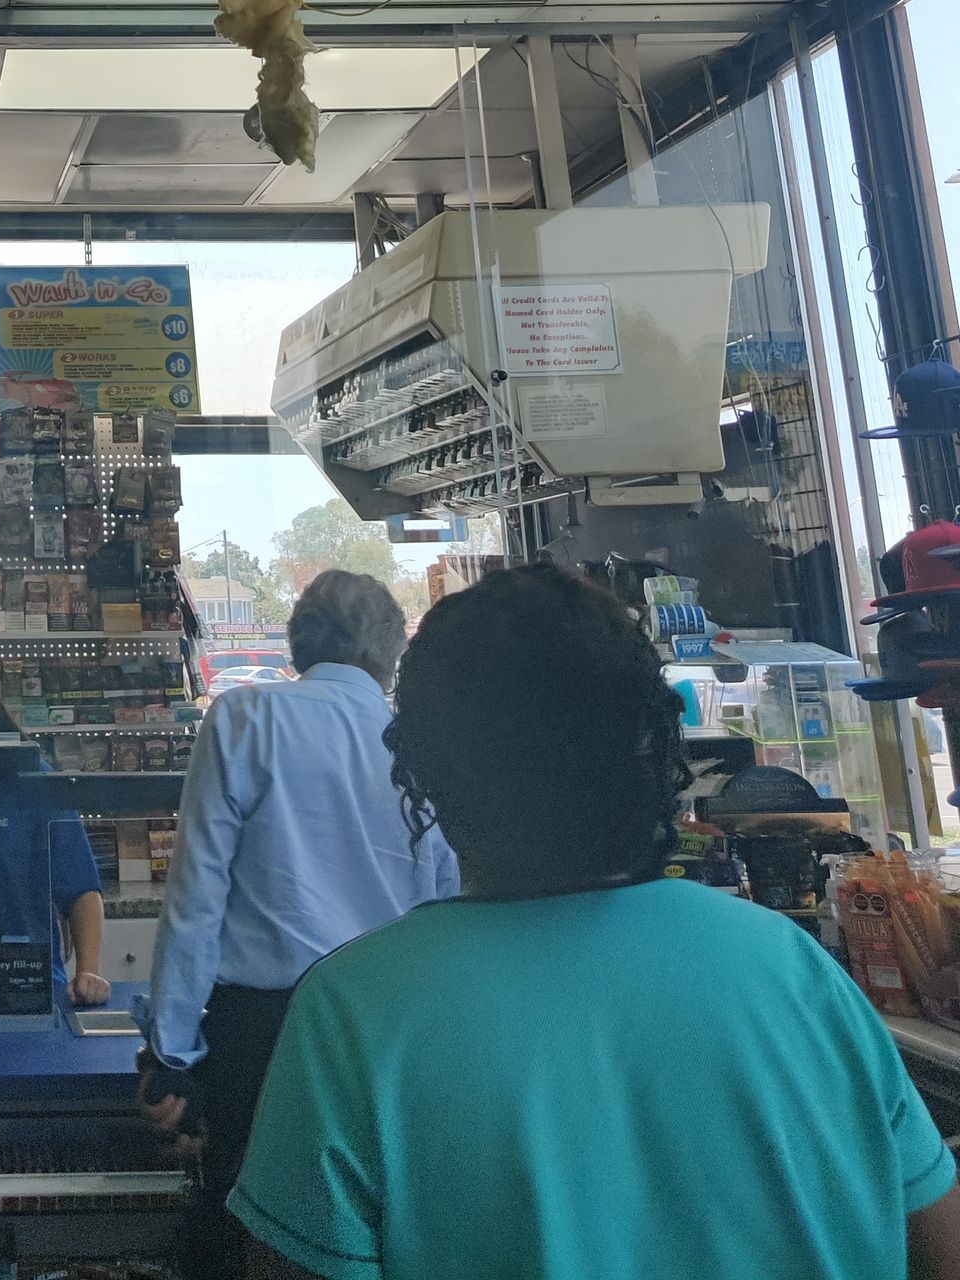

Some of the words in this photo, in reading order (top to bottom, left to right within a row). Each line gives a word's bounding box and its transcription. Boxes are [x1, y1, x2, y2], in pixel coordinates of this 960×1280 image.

[9, 269, 87, 307] Wash
[127, 279, 168, 304] Go
[511, 296, 535, 304] Credit
[538, 296, 559, 304] Cards
[504, 309, 533, 317] Named
[536, 308, 554, 316] Card
[556, 307, 583, 316] Holder
[27, 311, 64, 319] SUPER
[164, 320, 186, 335] $10
[532, 346, 551, 354] Take
[552, 346, 567, 354] Any
[570, 345, 614, 354] Complaints
[78, 353, 117, 362] WORKS
[169, 357, 186, 373] $8
[525, 359, 535, 367] To
[574, 357, 598, 365] Issuer
[123, 386, 157, 395] BASIC
[172, 388, 188, 404] $6
[215, 624, 253, 634] SERVICE
[681, 641, 704, 654] 1997
[13, 960, 42, 969] fill-up
